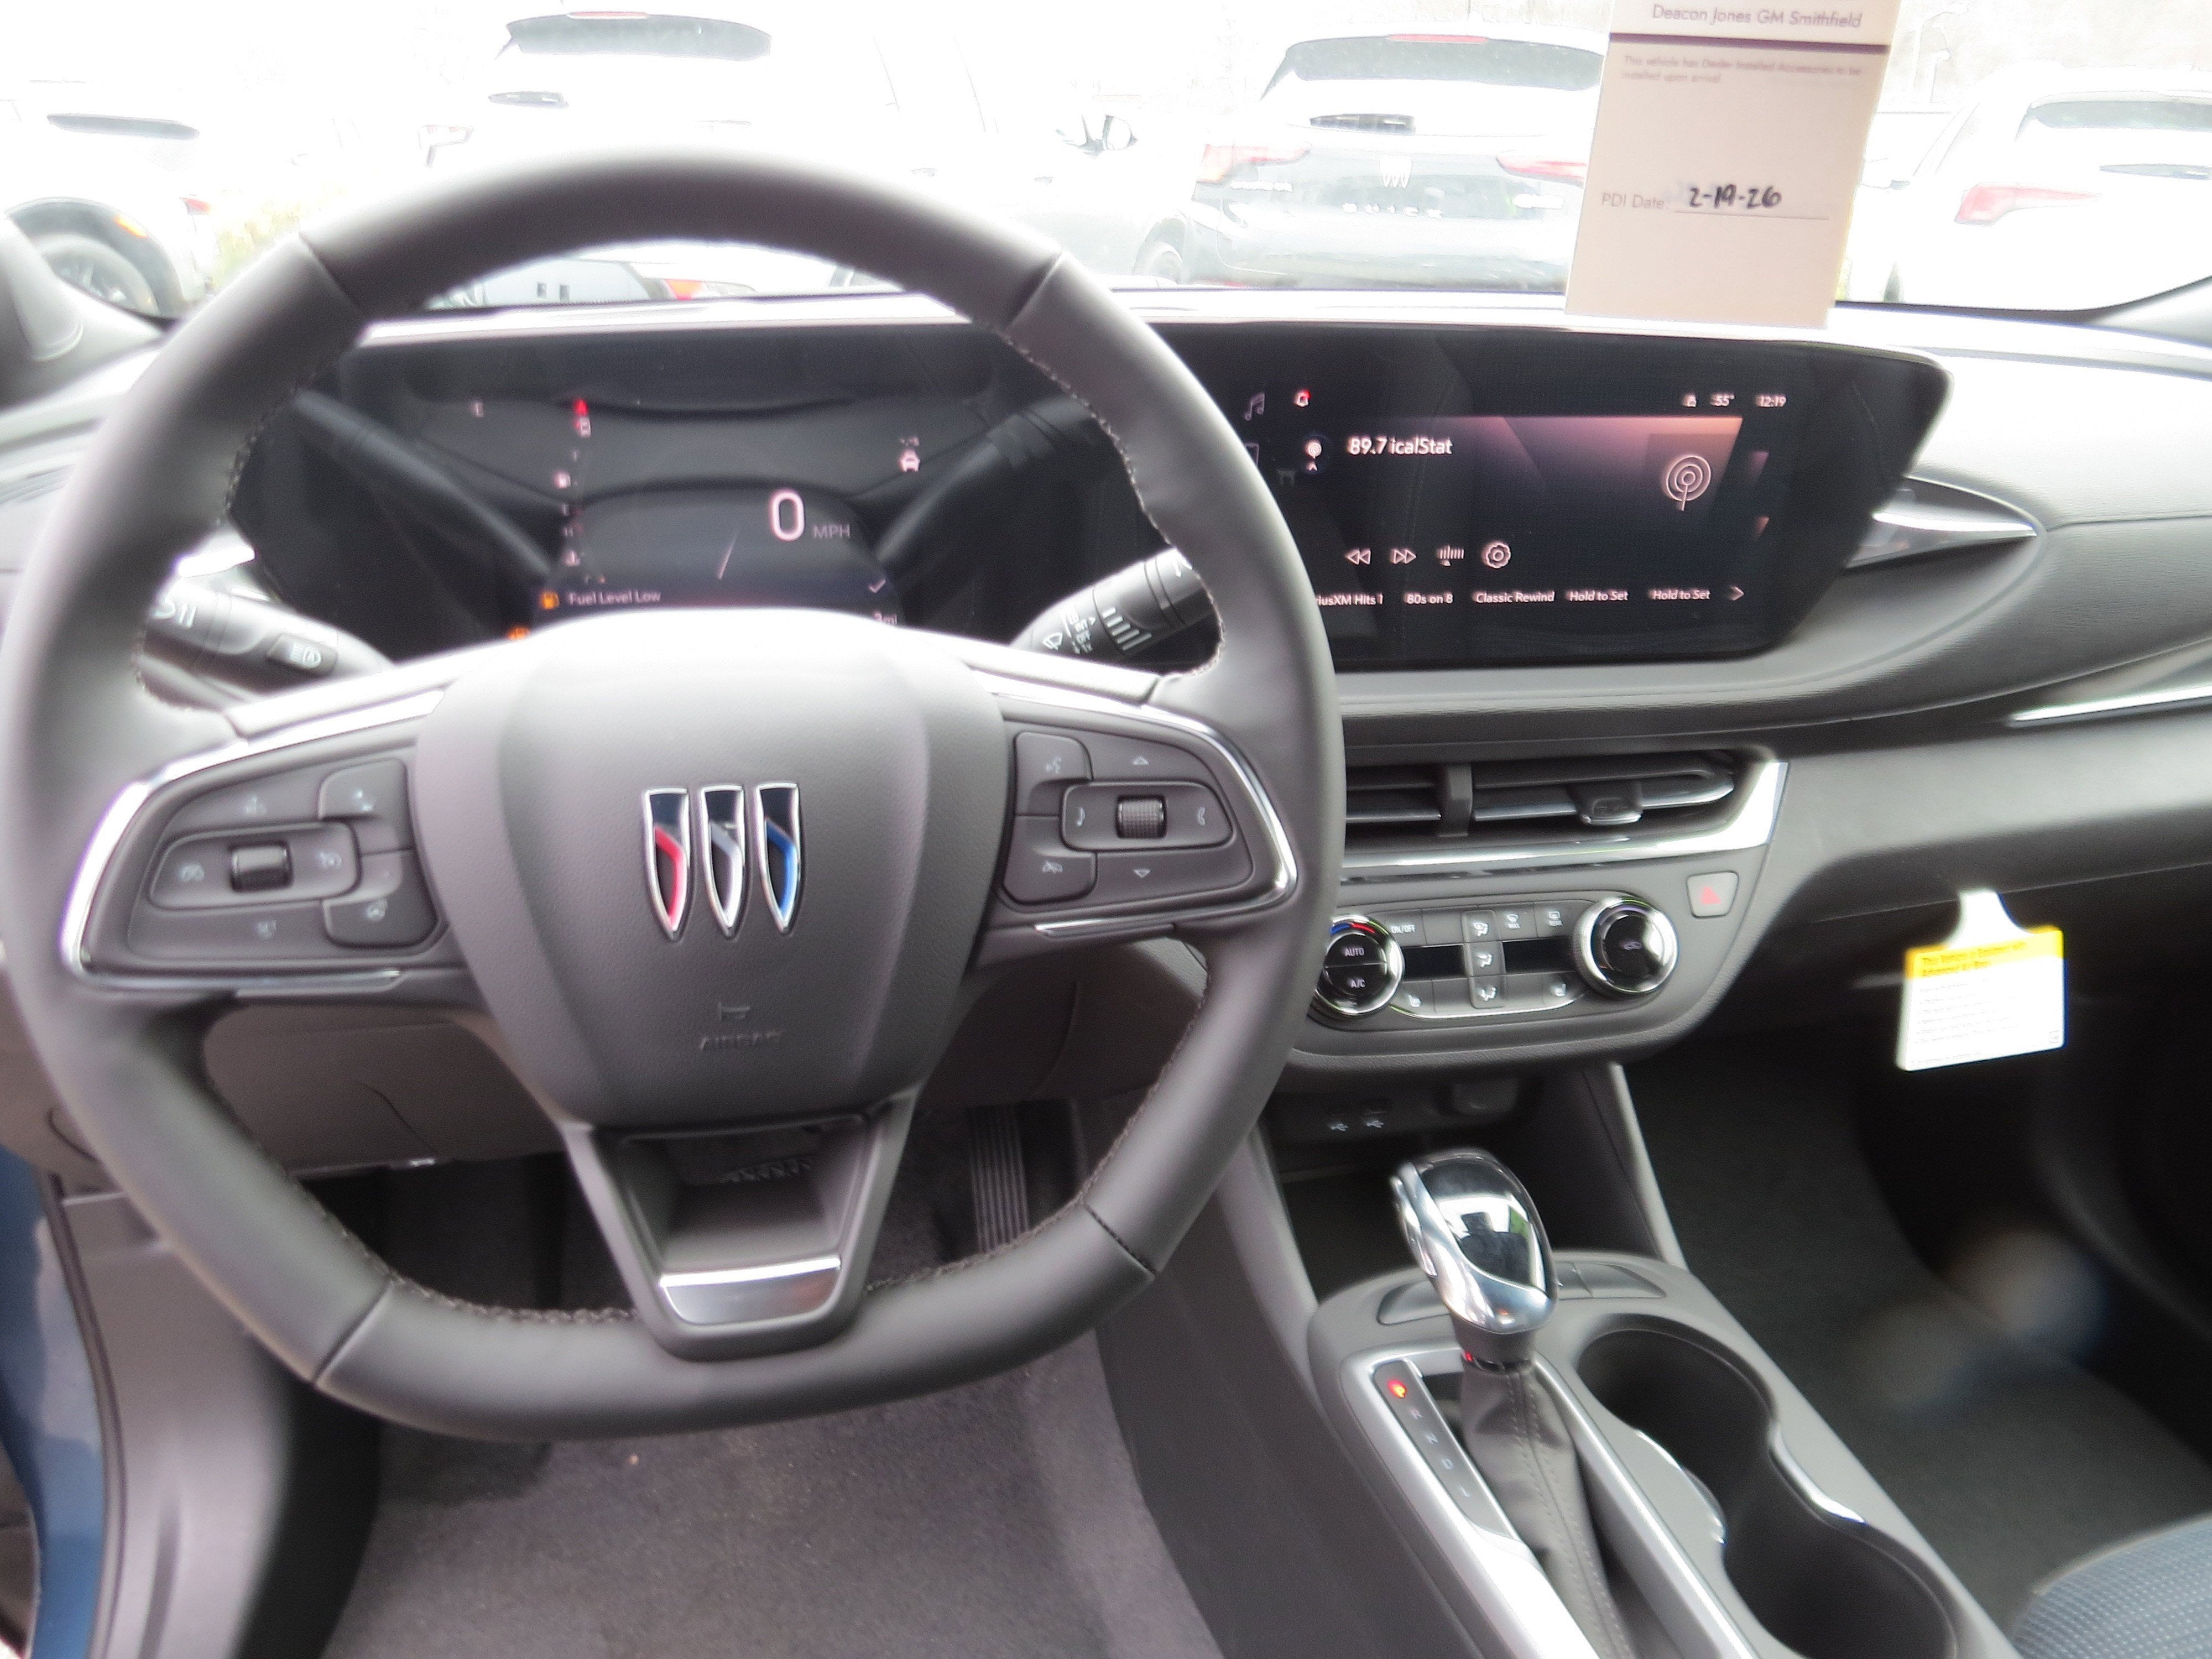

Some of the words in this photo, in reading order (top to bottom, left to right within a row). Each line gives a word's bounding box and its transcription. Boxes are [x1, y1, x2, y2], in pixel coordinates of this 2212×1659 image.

[1652, 4, 1707, 21] Deacon
[1710, 7, 1751, 25] Jones
[1757, 10, 1783, 24] GM
[1789, 11, 1864, 28] Smithfield
[1601, 192, 1626, 207] PDI
[1632, 195, 1669, 210] Date:
[1689, 183, 1783, 210] 2-19-26
[1759, 394, 1787, 408] 12:19
[1348, 435, 1388, 456] 89.7
[1389, 435, 1453, 456] icalStat
[771, 489, 805, 542] 0
[813, 525, 851, 539] MPH
[568, 591, 596, 605] Fuel
[599, 591, 632, 604] Level
[635, 590, 661, 603] Low
[1355, 593, 1376, 605] Hits
[1407, 593, 1427, 604] 80s
[1430, 595, 1443, 604] on
[1446, 592, 1454, 604] 8
[1475, 591, 1513, 604] Classic
[1515, 590, 1556, 603] Rewind
[1569, 589, 1595, 602] Hold
[1597, 591, 1609, 602] to
[1610, 589, 1629, 602] Set
[1653, 589, 1678, 601] Hold
[1680, 590, 1692, 601] to
[1693, 589, 1711, 601] Set
[1391, 924, 1416, 934] ON/OFF
[1344, 947, 1365, 957] AUTO
[1350, 979, 1366, 989] A/C
